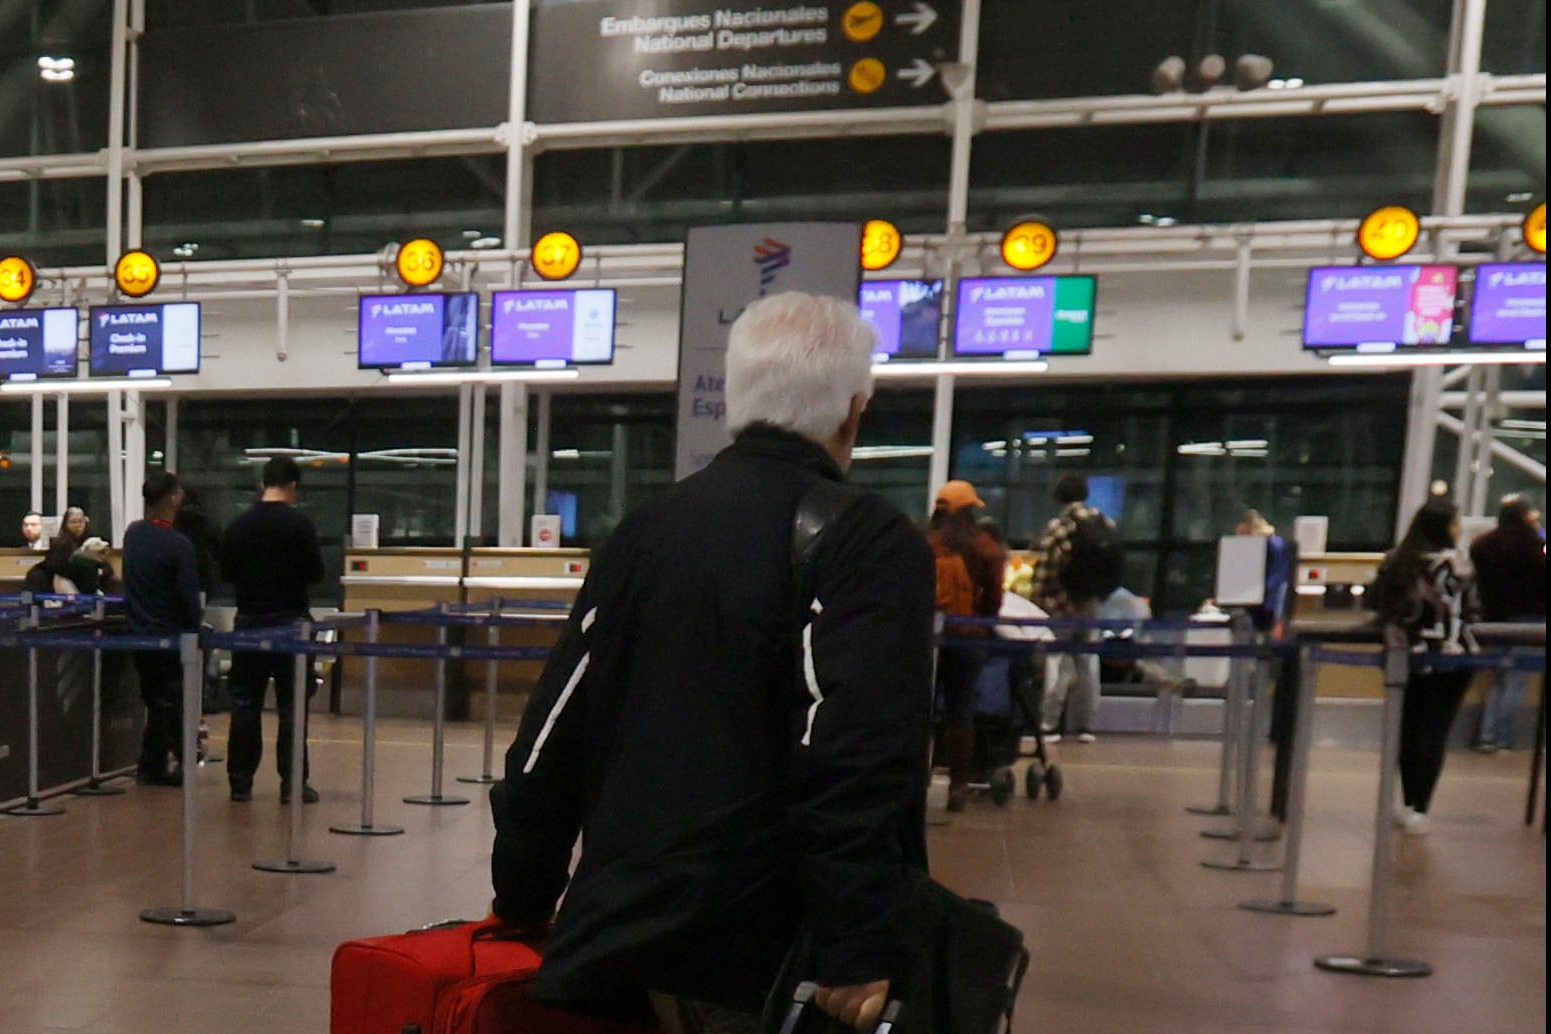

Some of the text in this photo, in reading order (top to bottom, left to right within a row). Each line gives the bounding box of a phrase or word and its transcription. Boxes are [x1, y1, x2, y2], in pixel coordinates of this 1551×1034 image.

[713, 7, 829, 27] Nacionales
[633, 28, 827, 52] National Departures
[639, 62, 840, 87] Conexiones Nacionales
[658, 80, 840, 102] National Connections
[406, 251, 436, 272] 36
[1, 268, 26, 288] 34
[382, 303, 435, 316] LATAM
[515, 299, 569, 312] LATAM
[110, 313, 158, 325] LATAM
